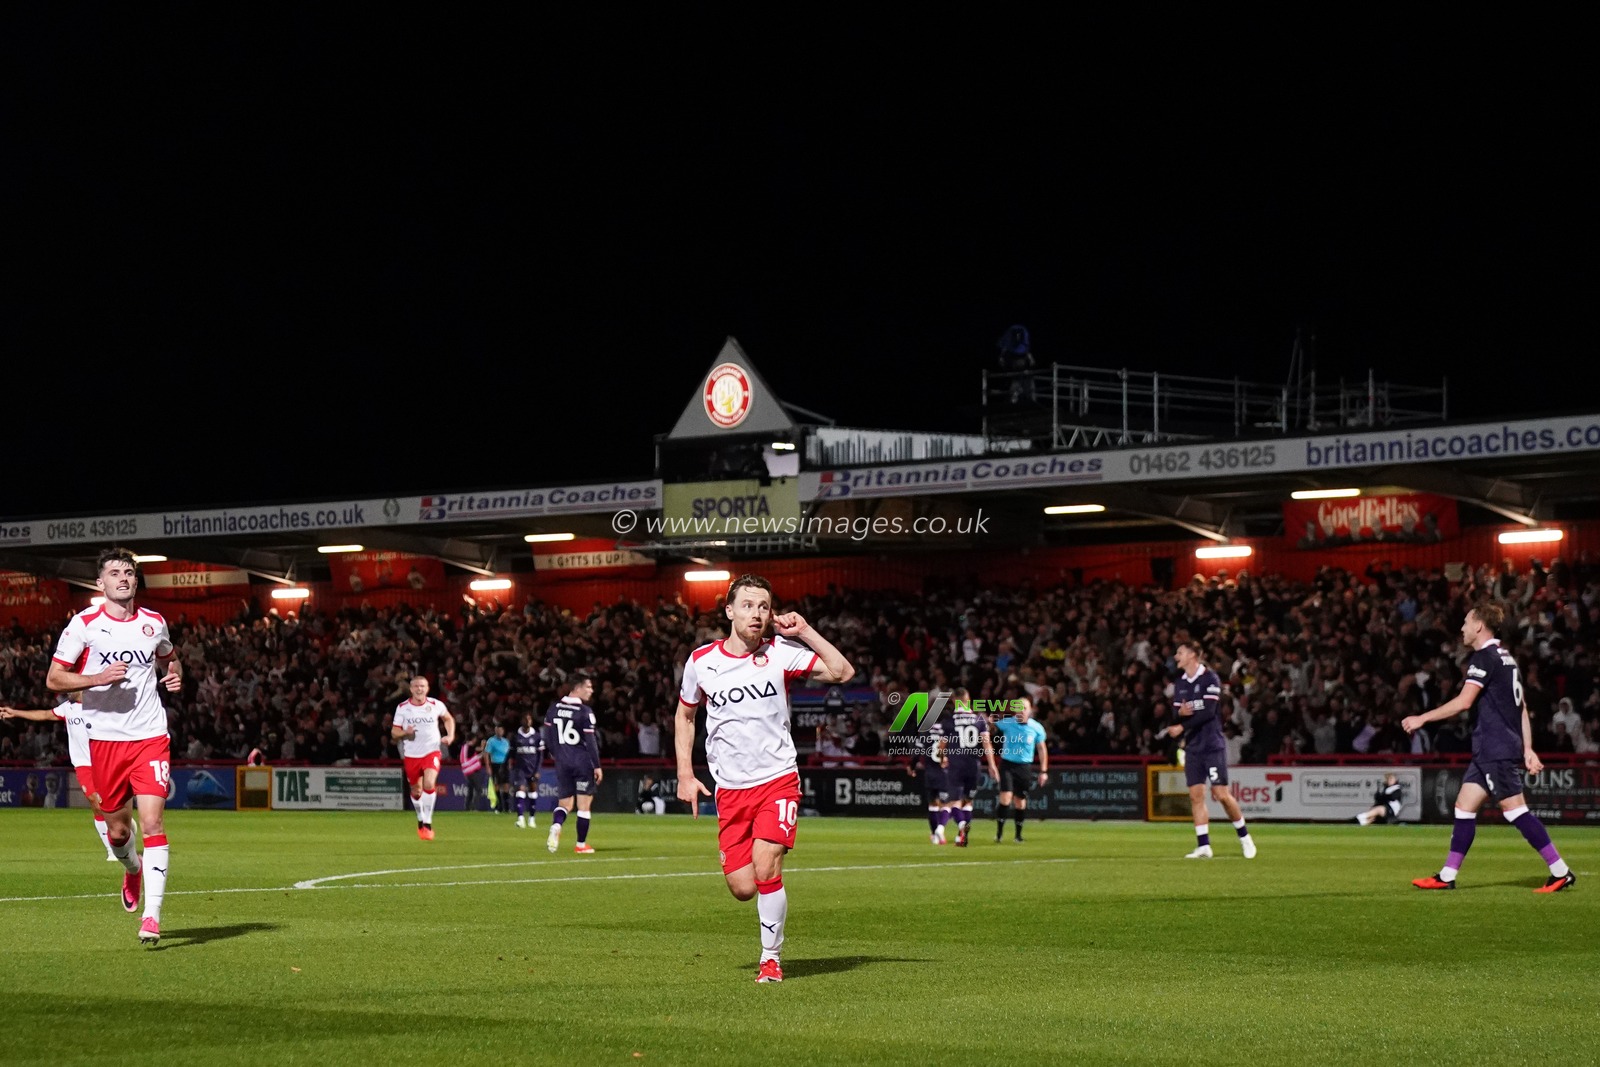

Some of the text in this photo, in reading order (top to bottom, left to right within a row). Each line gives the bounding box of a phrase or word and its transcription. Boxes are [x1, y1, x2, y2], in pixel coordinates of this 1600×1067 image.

[819, 446, 1276, 497] Britannia Coaches 01462 436125
[419, 485, 656, 521] Britannia Coaches
[692, 495, 771, 520] SPORTA
[47, 519, 137, 540] 01462 436125
[163, 504, 365, 536] britanniacoaches.co.uk
[707, 681, 778, 708] XSOLLA
[1512, 668, 1523, 707] 6
[553, 718, 580, 746] 16
[954, 725, 979, 749] 10
[149, 760, 170, 782] 18
[1209, 766, 1219, 781] 5
[1485, 773, 1494, 791] 6
[275, 770, 310, 803] TAE
[855, 779, 903, 791] Balstone
[855, 792, 921, 805] Investments
[774, 798, 798, 827] 10
